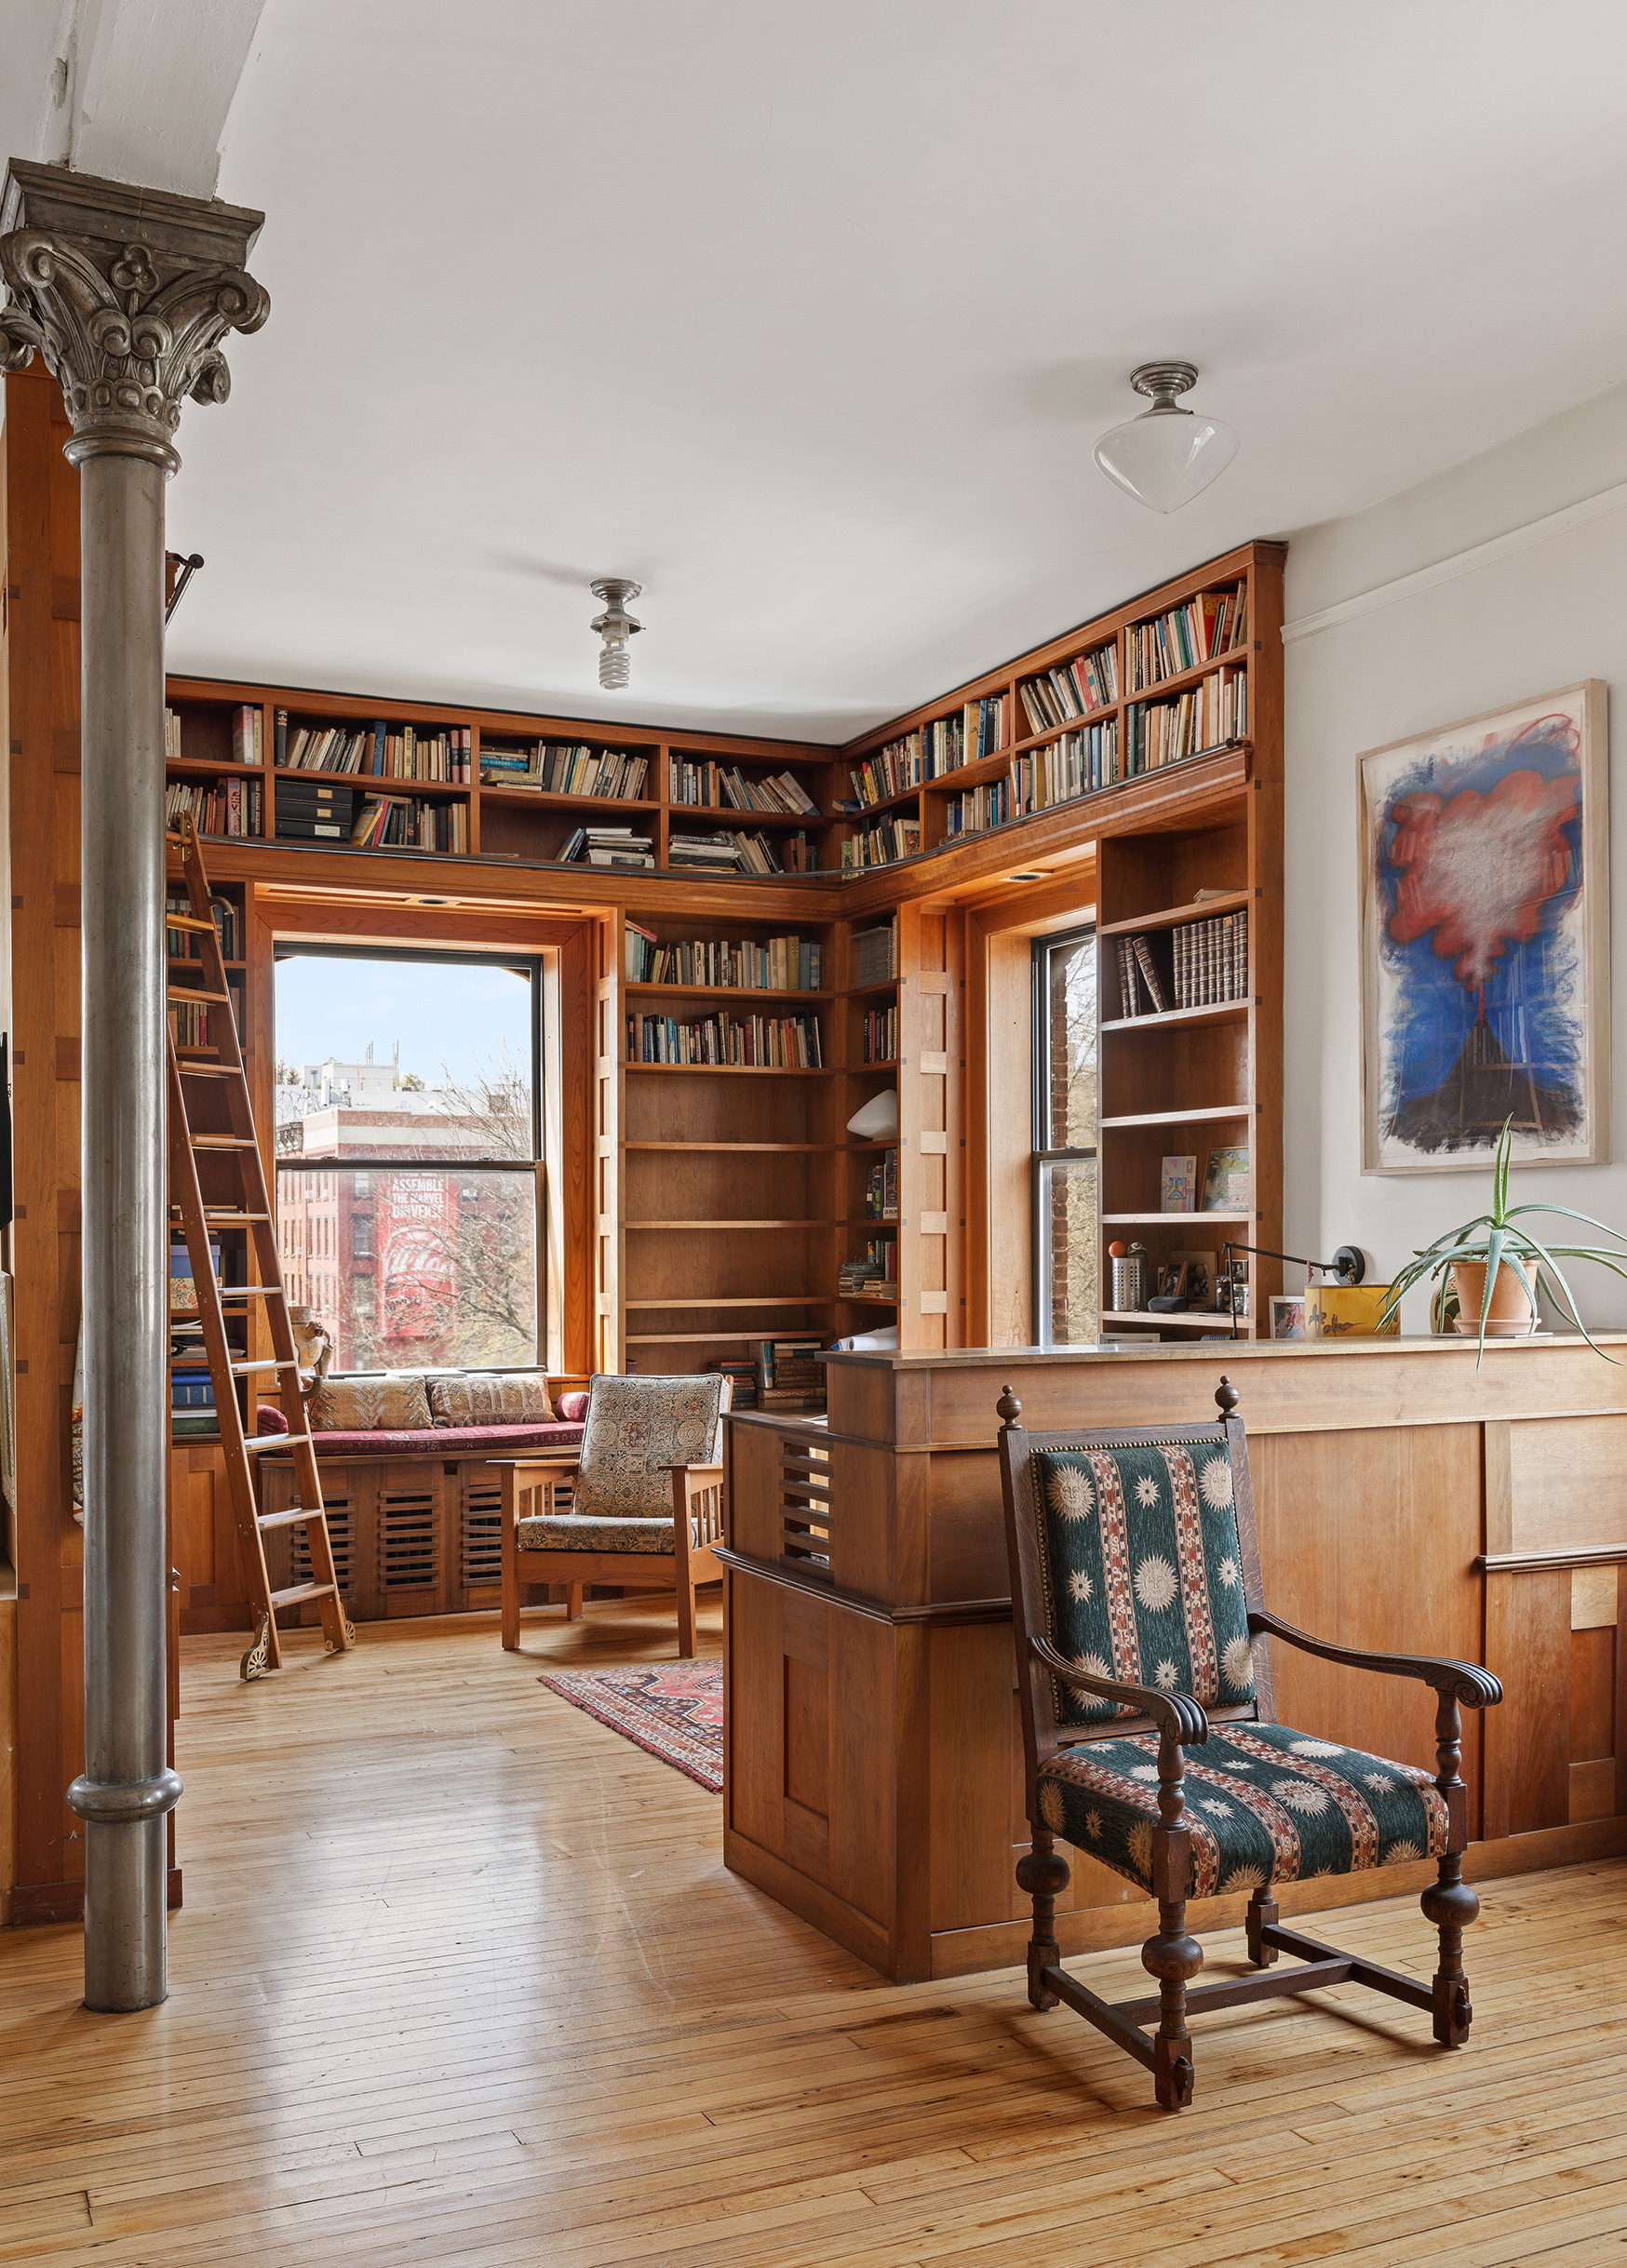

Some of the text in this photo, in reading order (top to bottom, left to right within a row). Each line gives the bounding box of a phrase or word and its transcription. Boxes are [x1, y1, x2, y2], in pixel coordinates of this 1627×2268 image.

[392, 1178, 445, 1192] ASSEMBLE
[392, 1192, 445, 1203] THE MARVEL
